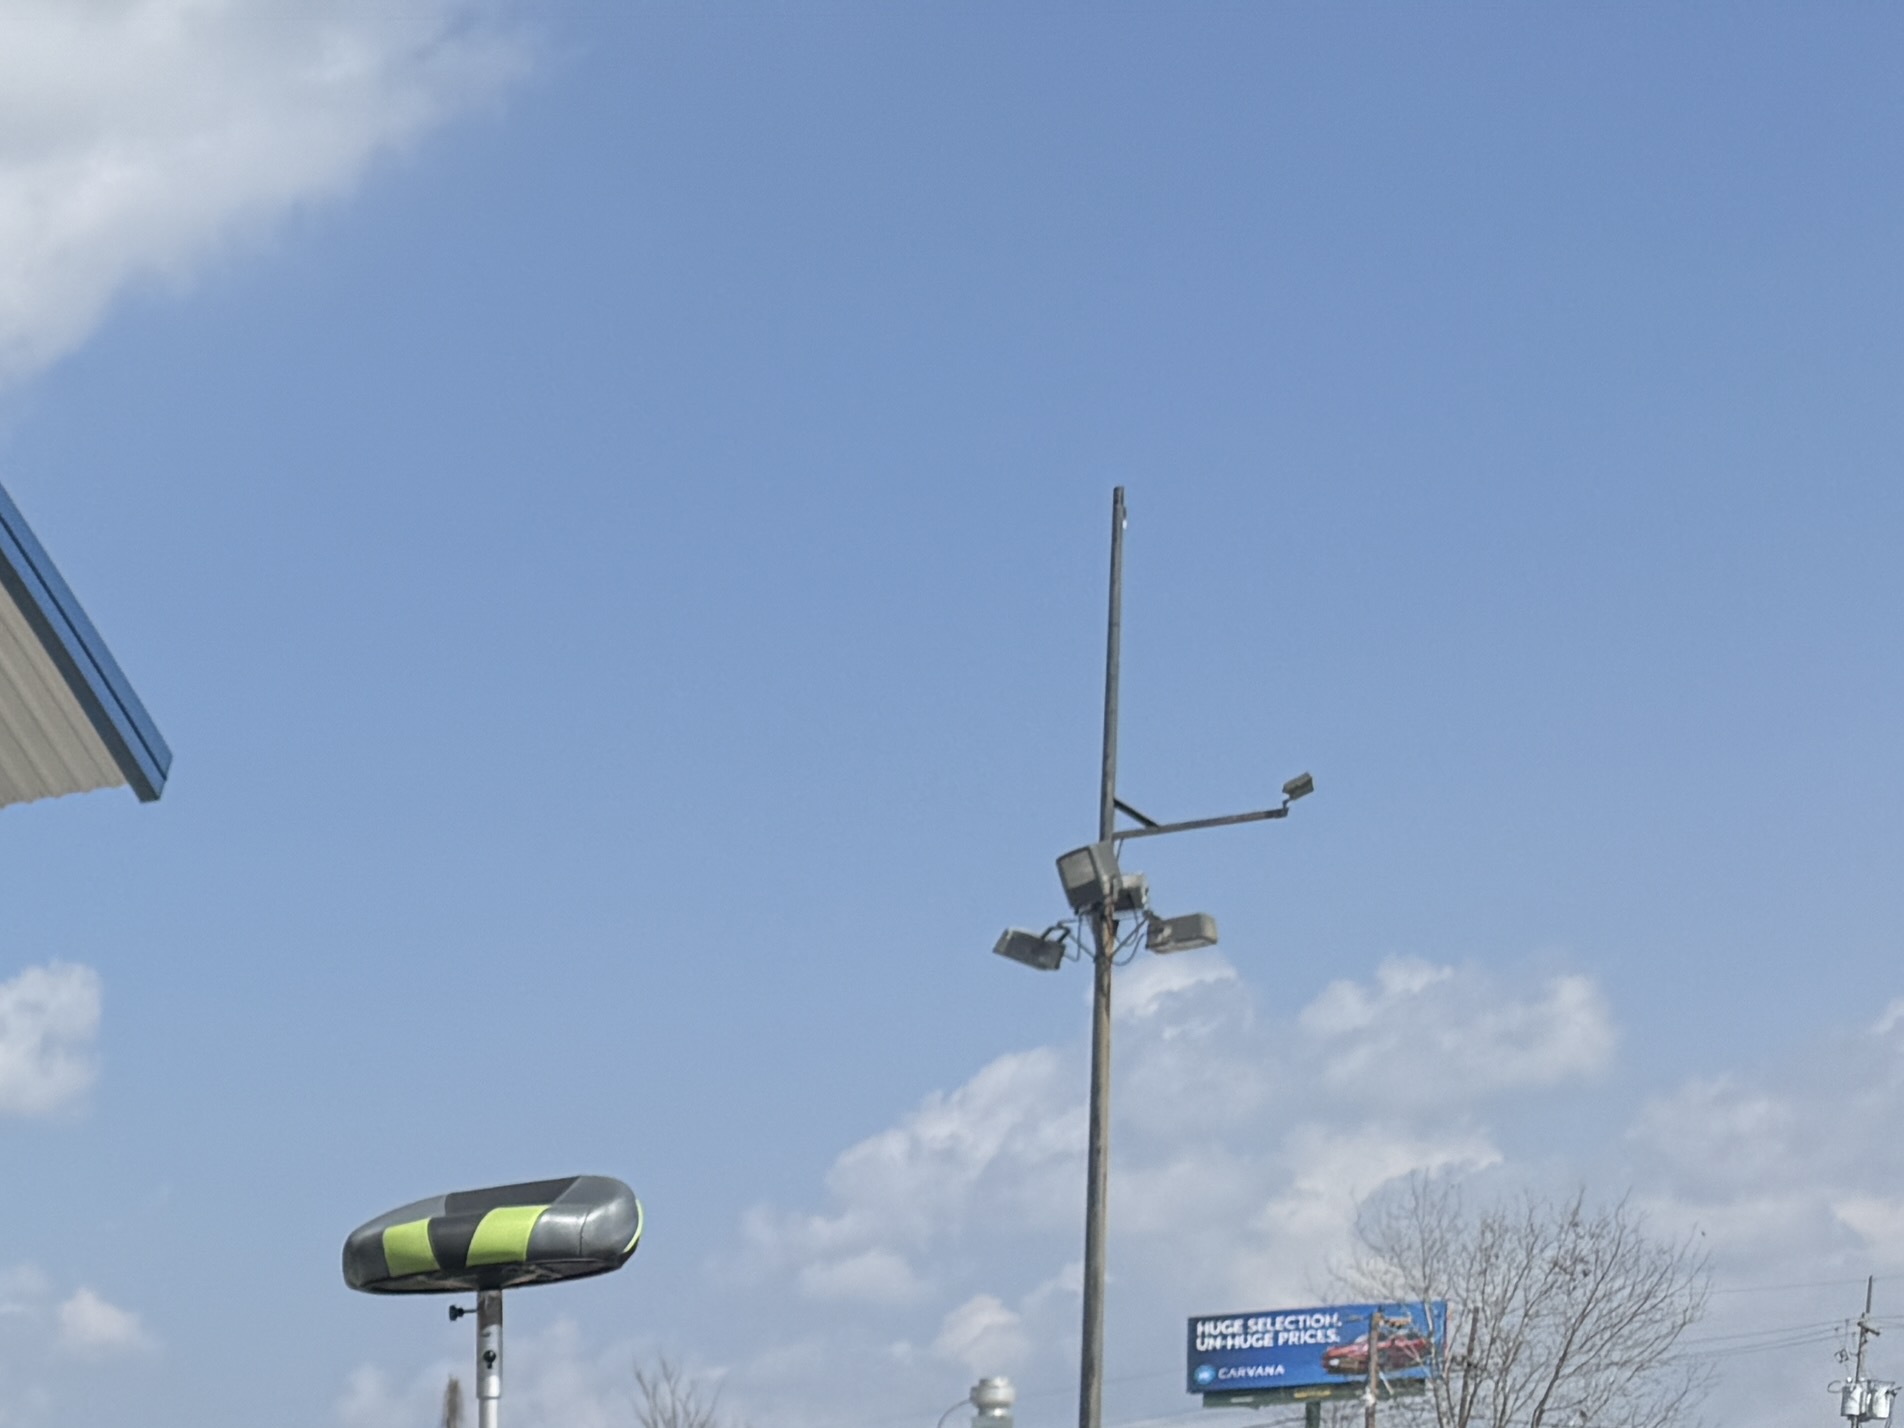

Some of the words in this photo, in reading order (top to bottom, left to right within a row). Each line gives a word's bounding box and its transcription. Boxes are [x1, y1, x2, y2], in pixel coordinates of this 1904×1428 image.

[1196, 1318, 1244, 1336] HUGE
[1247, 1312, 1342, 1333] SELECTION.
[1195, 1331, 1274, 1351] UN-HUGE
[1278, 1328, 1341, 1346] PRICES.
[1218, 1364, 1285, 1380] CARVANA
